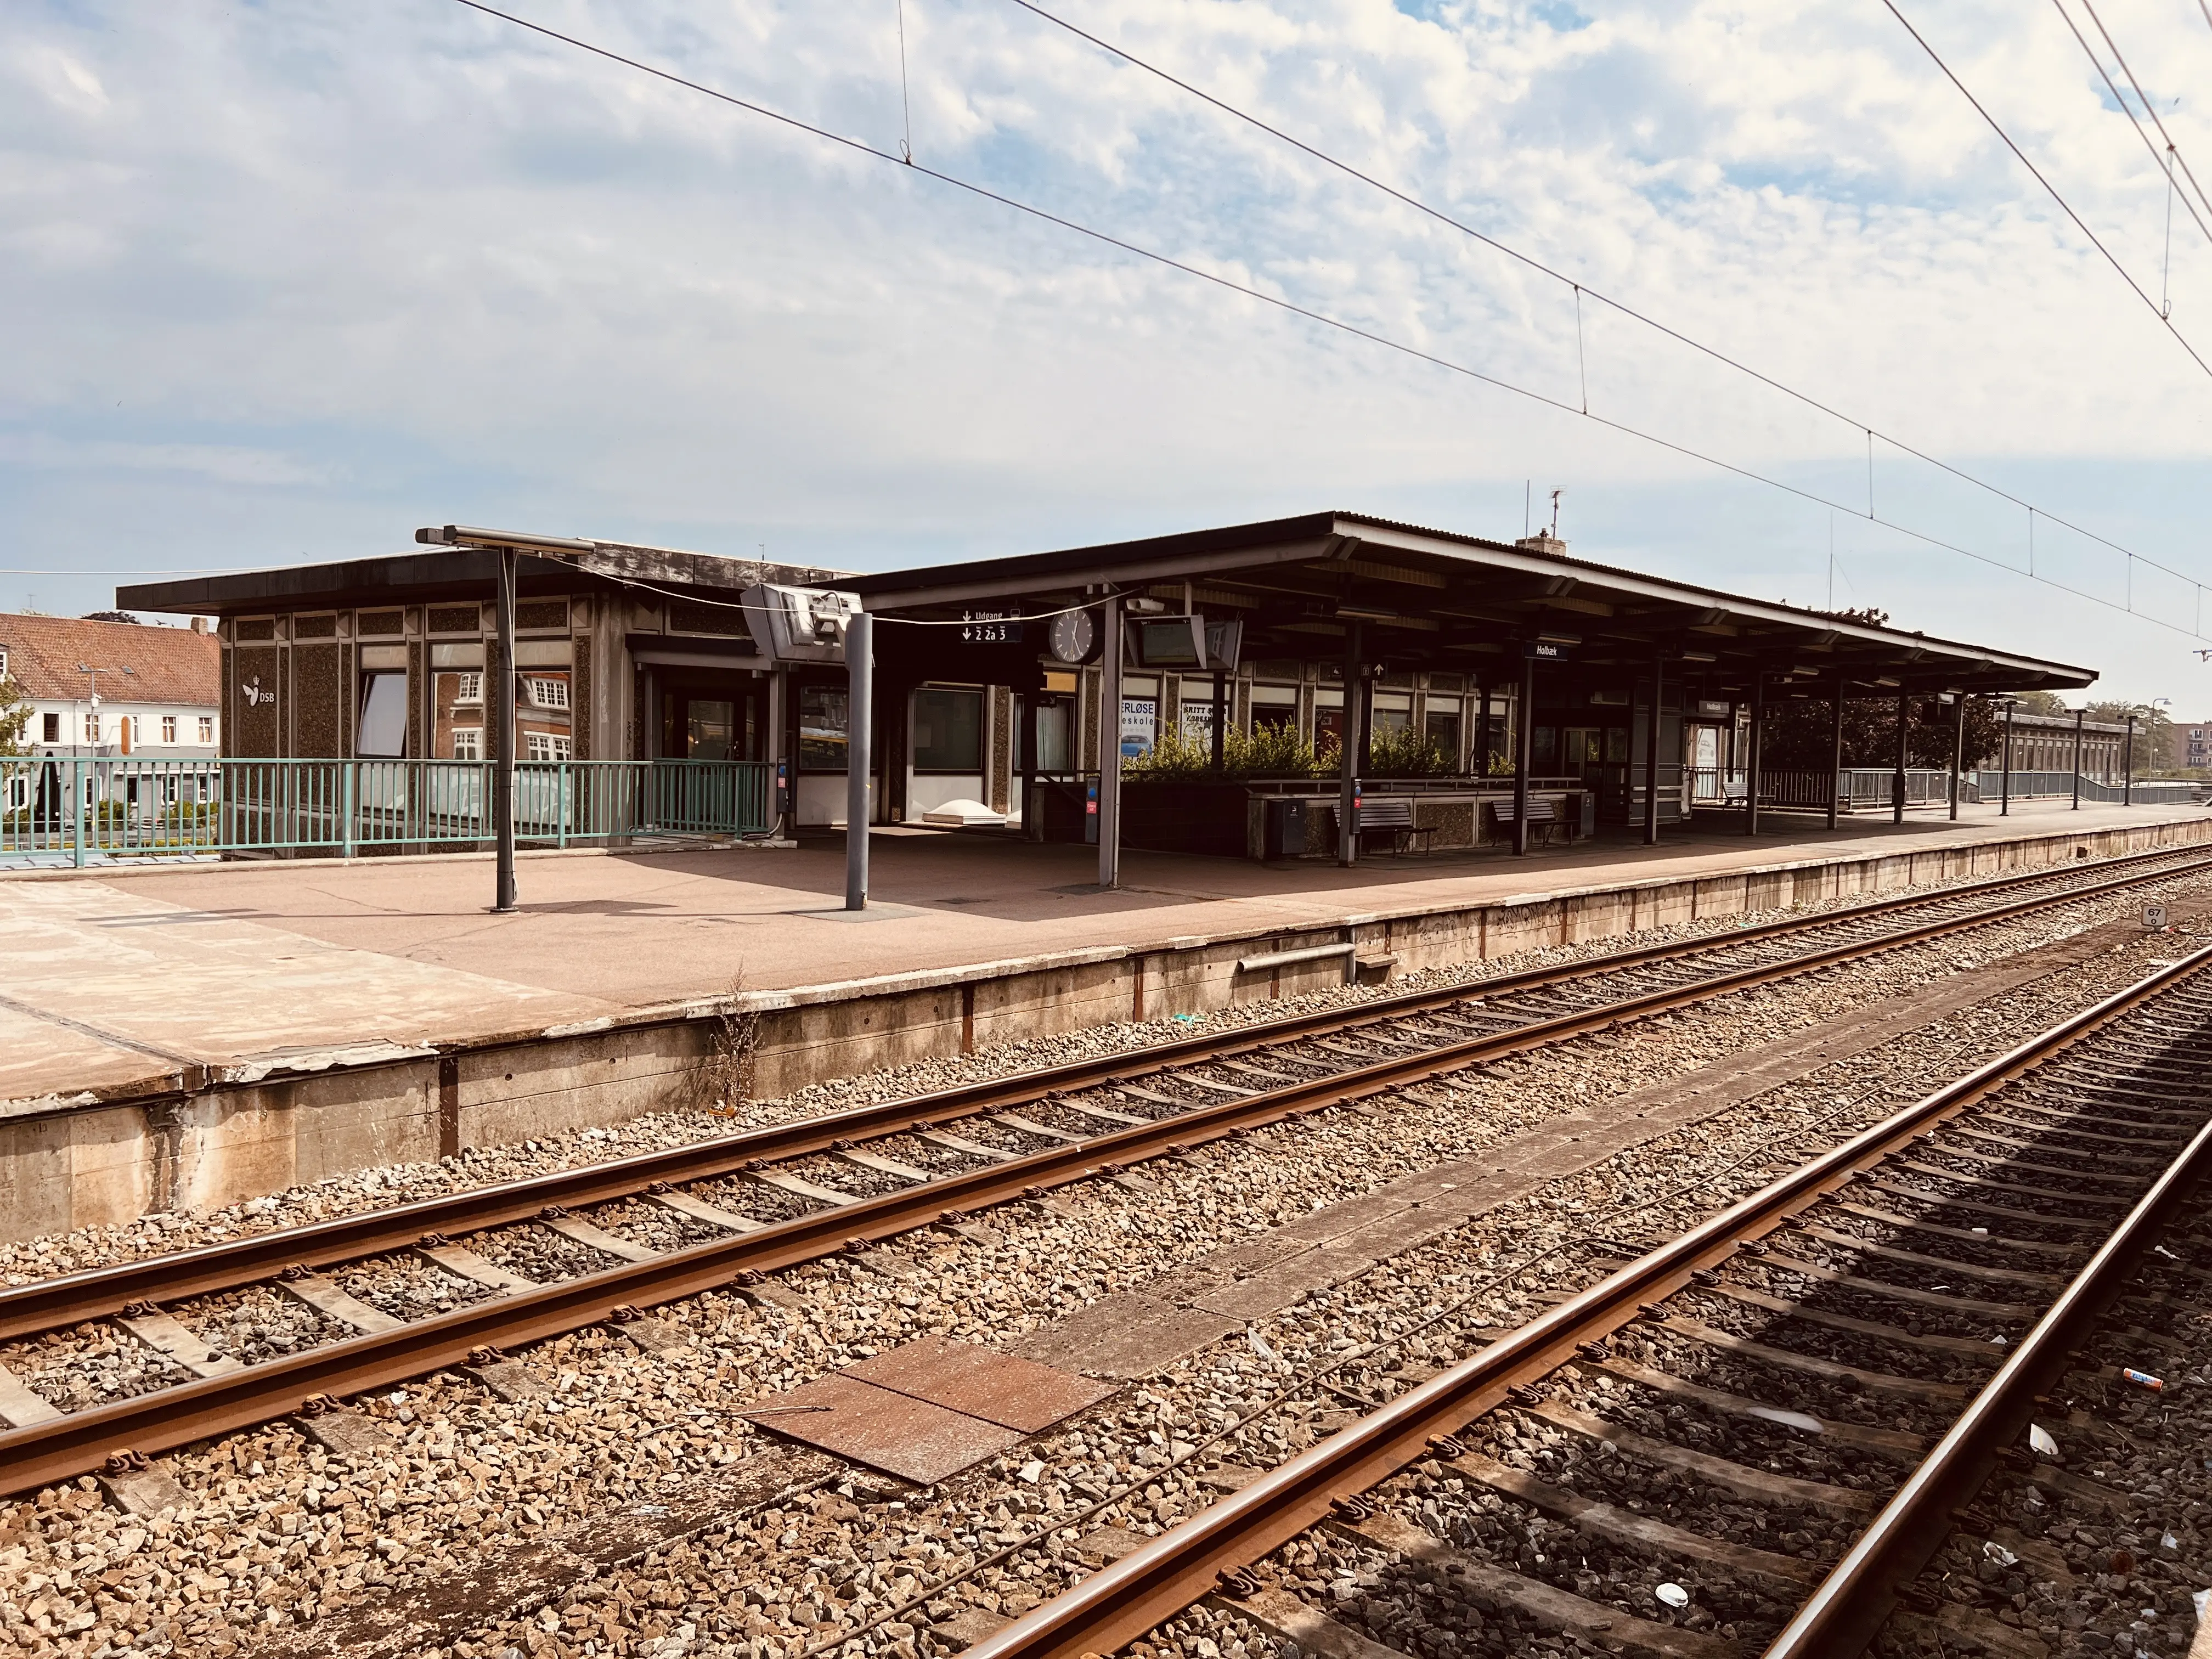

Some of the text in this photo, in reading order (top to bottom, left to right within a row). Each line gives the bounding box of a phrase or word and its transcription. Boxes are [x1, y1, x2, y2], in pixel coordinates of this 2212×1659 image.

[975, 612, 1002, 620] Udgang
[975, 629, 1006, 640] 2 2a 3
[1537, 645, 1558, 656] Holbæk
[259, 692, 274, 702] DSB
[1122, 716, 1153, 725] eskole
[2148, 908, 2161, 917] 67
